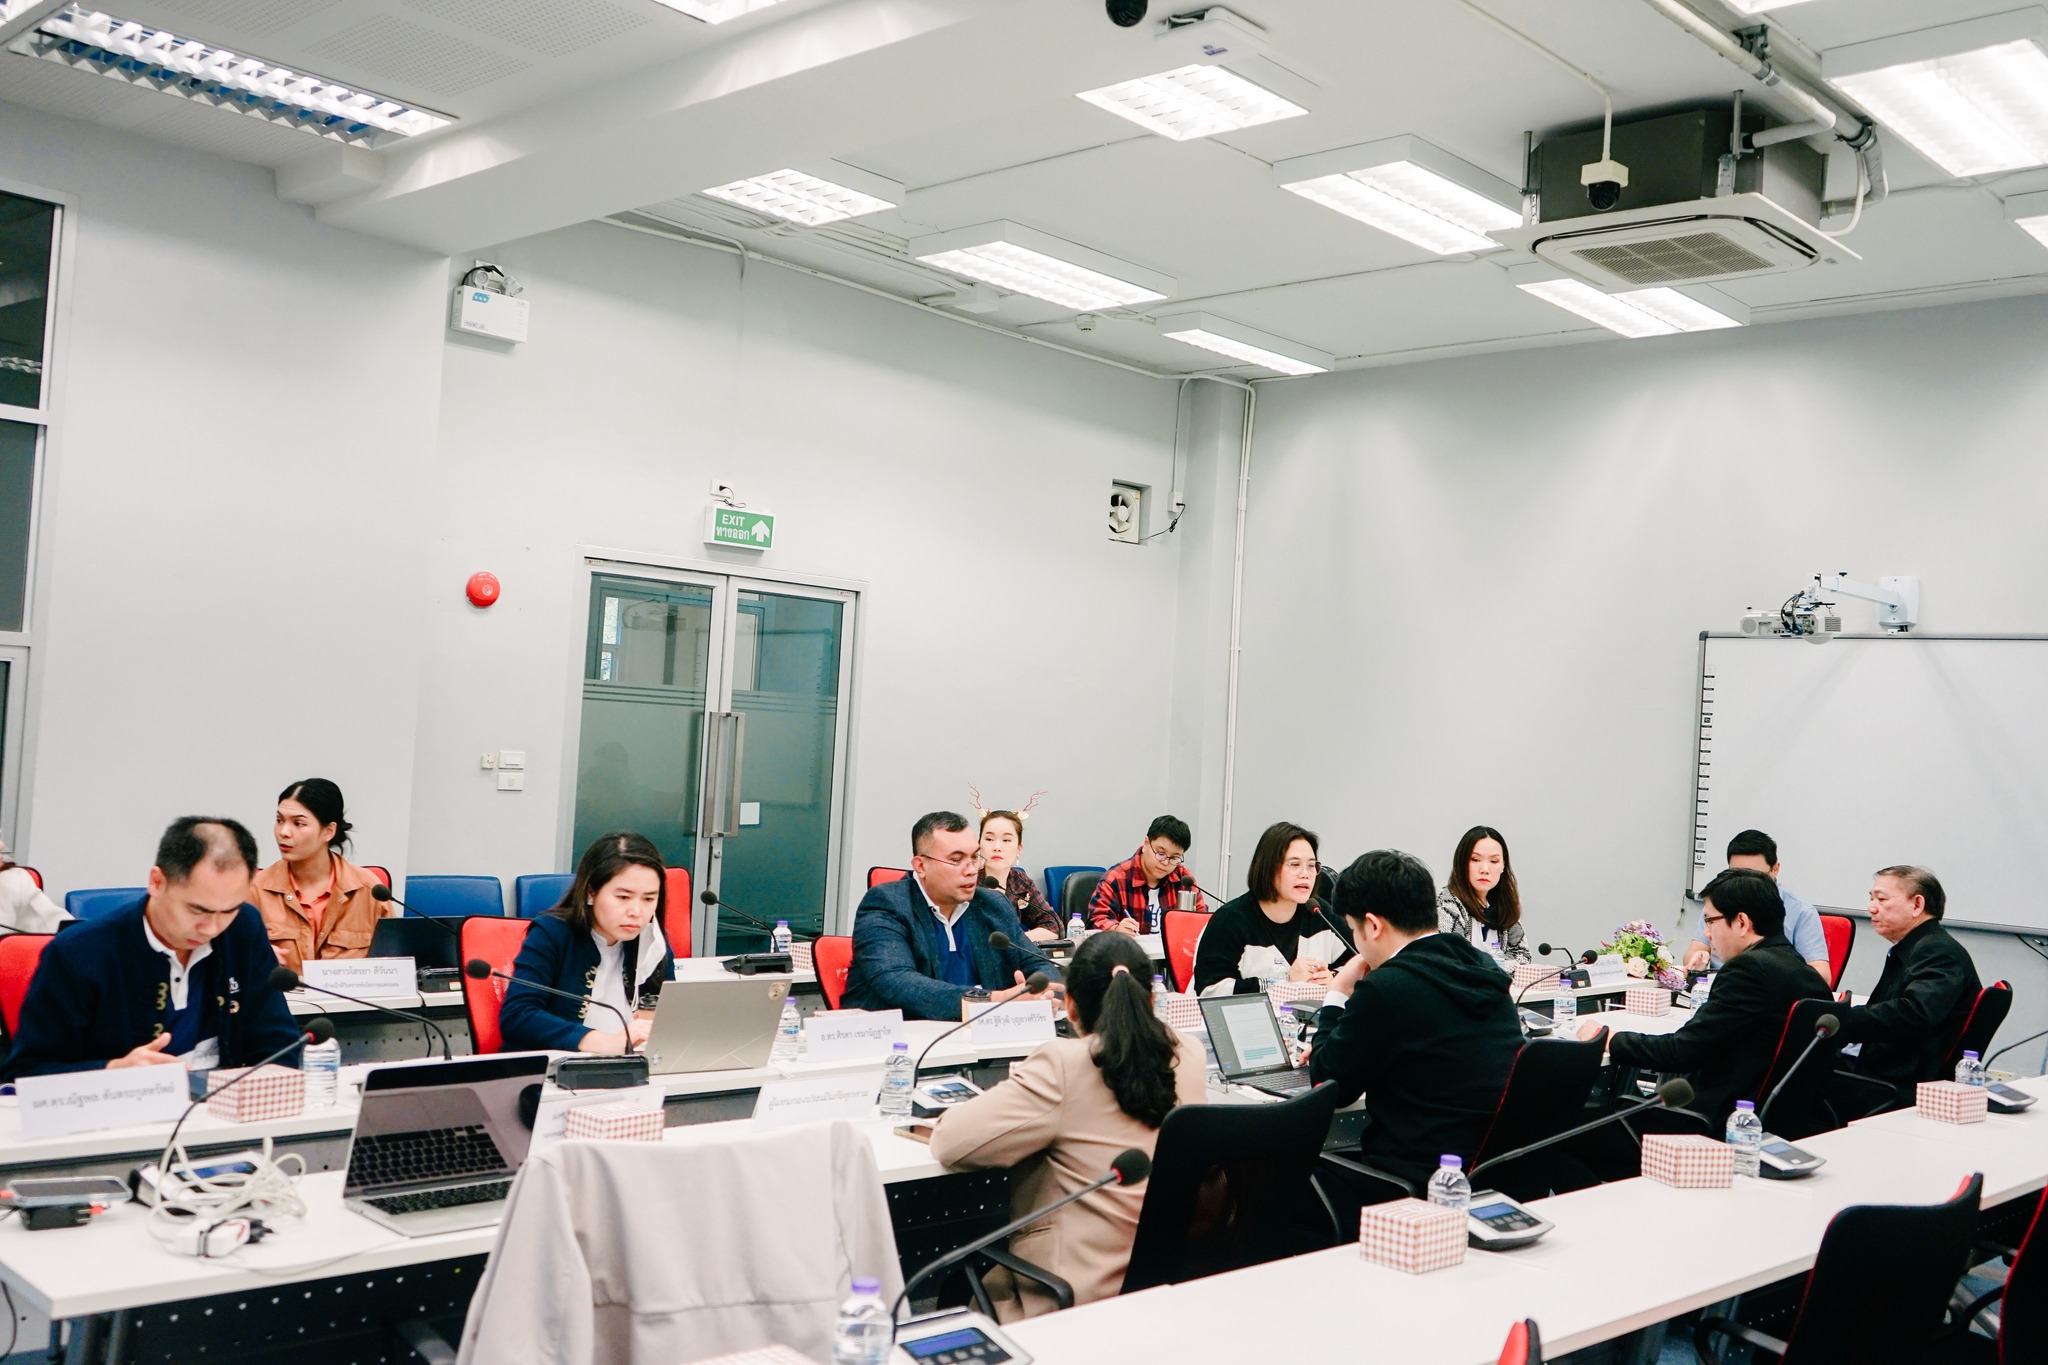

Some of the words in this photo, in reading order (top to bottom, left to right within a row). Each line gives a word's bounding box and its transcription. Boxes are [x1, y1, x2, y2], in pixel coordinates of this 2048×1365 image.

[721, 514, 745, 526] EXIT
[716, 526, 750, 540] ทางออก
